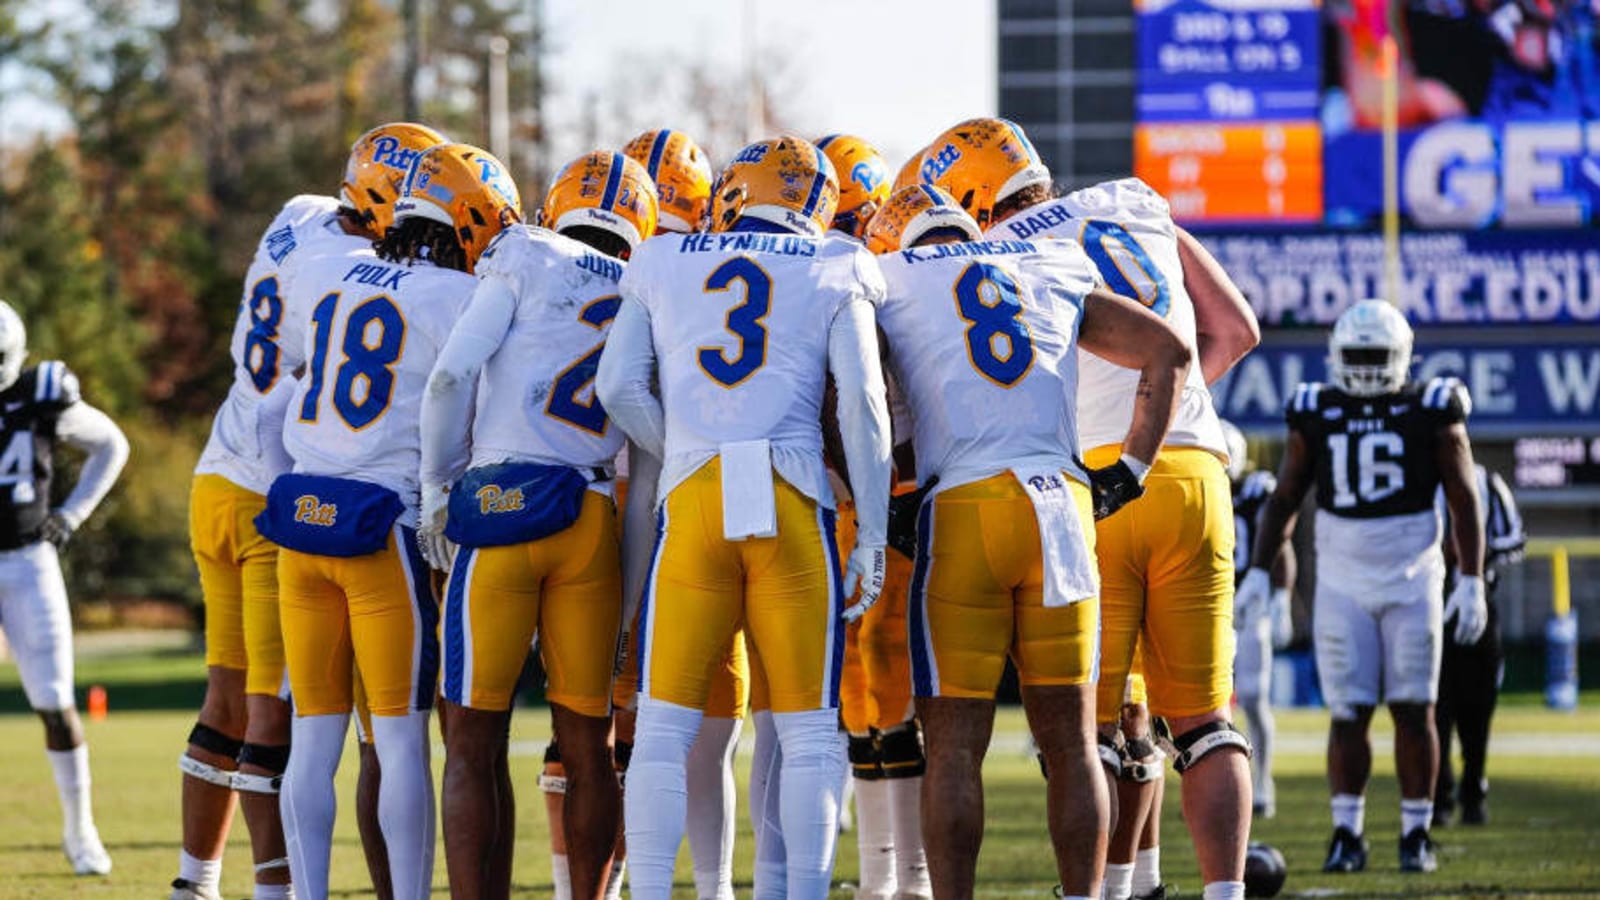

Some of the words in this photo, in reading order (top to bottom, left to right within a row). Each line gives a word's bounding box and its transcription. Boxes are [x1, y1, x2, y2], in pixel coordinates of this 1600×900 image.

[920, 143, 961, 185] Pitt
[1008, 204, 1075, 240] BAER
[680, 232, 816, 258] REYNOLDS
[343, 262, 412, 292] POLK
[697, 254, 775, 390] 3
[953, 260, 1036, 390] 8
[299, 290, 408, 433] 18
[545, 294, 624, 438] 2
[1327, 432, 1405, 508] 16
[294, 494, 338, 527] Pitt
[476, 484, 526, 516] Pitt
